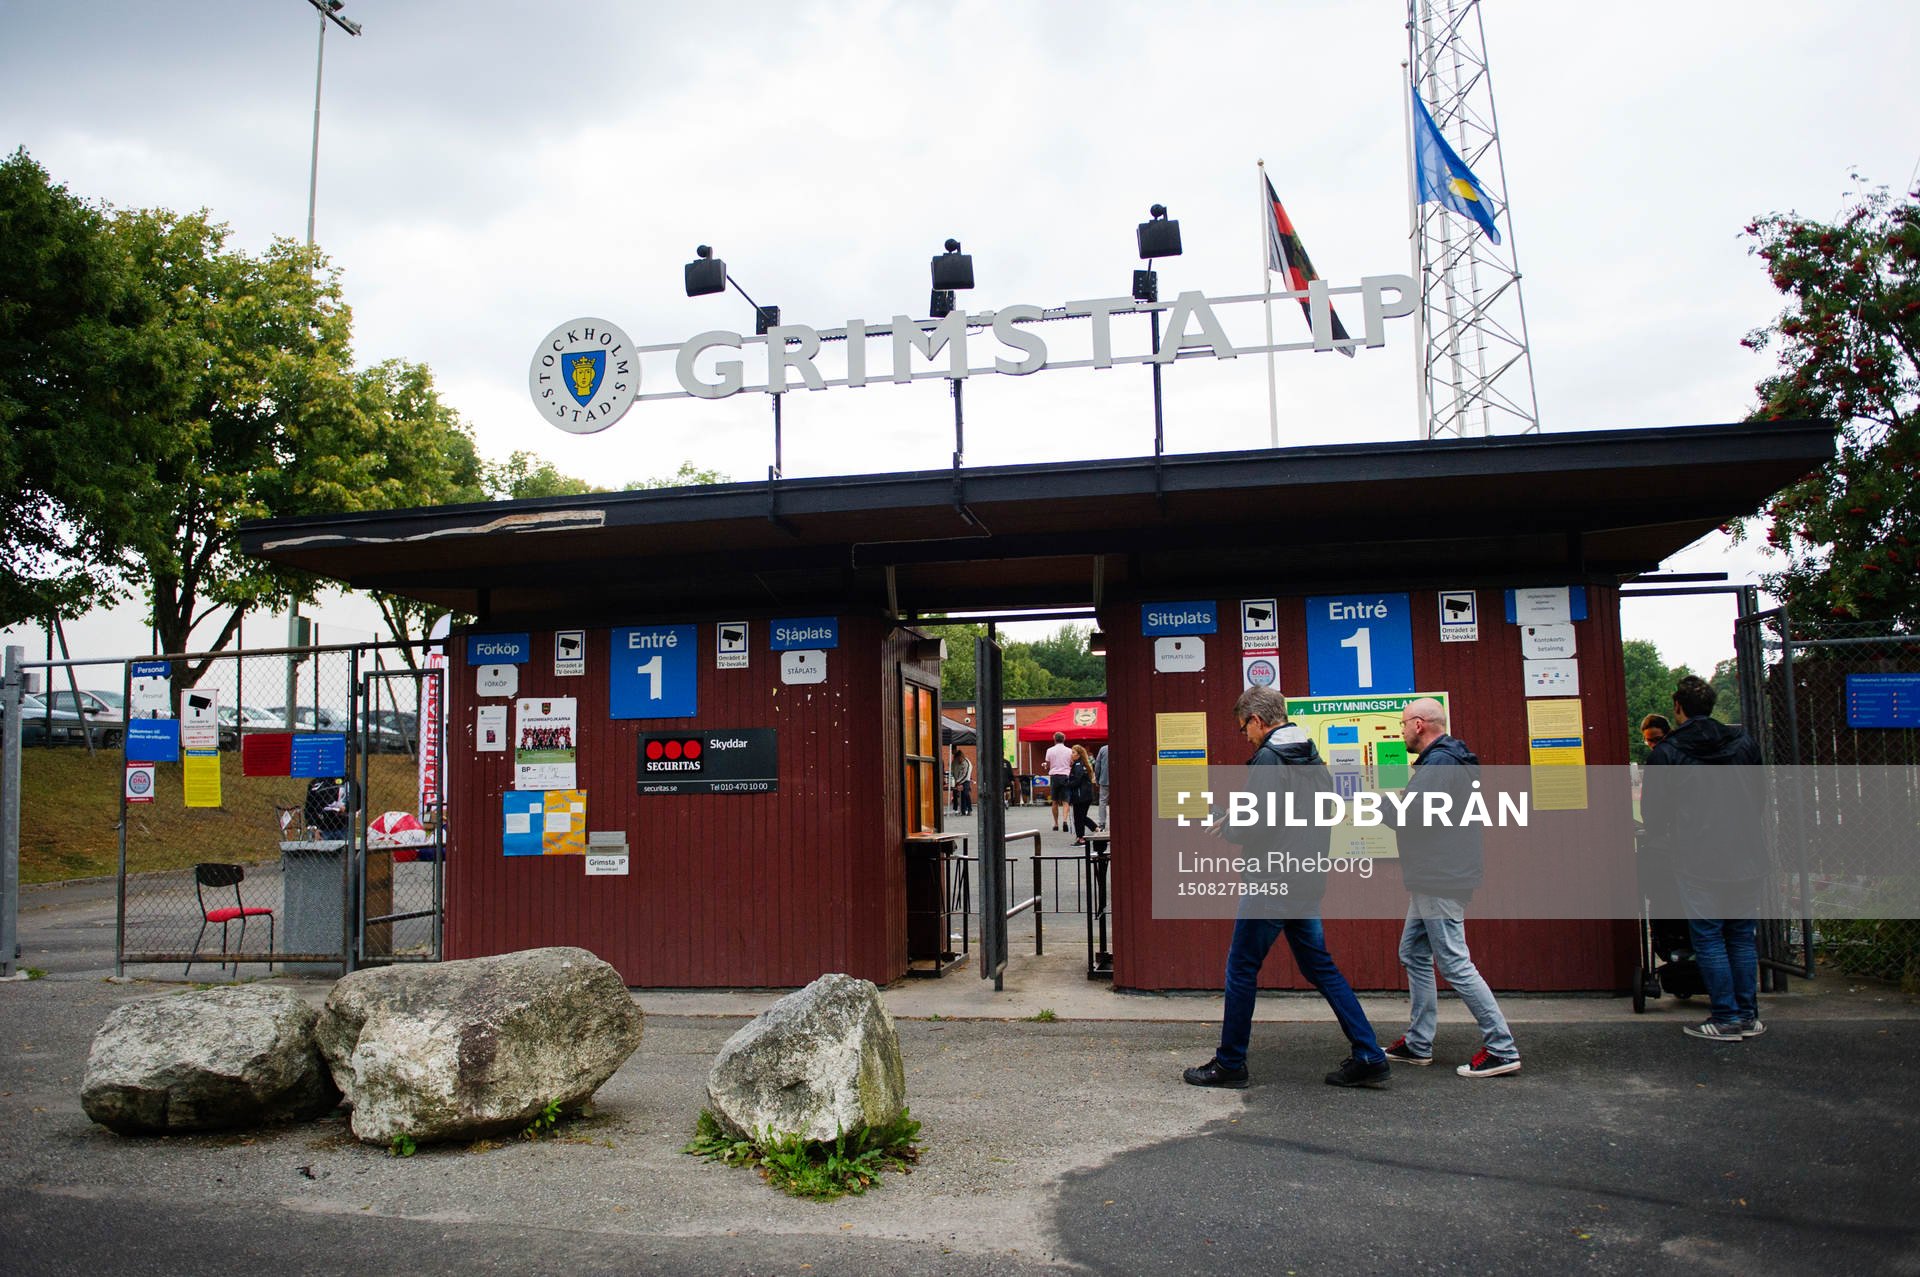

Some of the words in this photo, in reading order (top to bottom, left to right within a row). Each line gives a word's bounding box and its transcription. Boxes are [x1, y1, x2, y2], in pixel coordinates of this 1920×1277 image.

[676, 290, 1238, 400] GRIMSTA
[1308, 274, 1421, 352] IP
[540, 328, 629, 398] STOCKHOLMS
[556, 402, 611, 422] STAD
[1328, 600, 1388, 621] Entré
[1147, 612, 1211, 627] Sittplats
[628, 630, 678, 649] Entré
[776, 627, 832, 642] Ståplats
[476, 642, 520, 656] Förköp
[1340, 627, 1373, 688] 1
[637, 656, 662, 700] 1
[787, 666, 817, 675] STÅPLATS
[1313, 699, 1415, 713] UTRYMNINGSPLA
[710, 739, 748, 750] Skyddar
[646, 761, 701, 771] SECURITAS
[720, 783, 748, 791] 010-470
